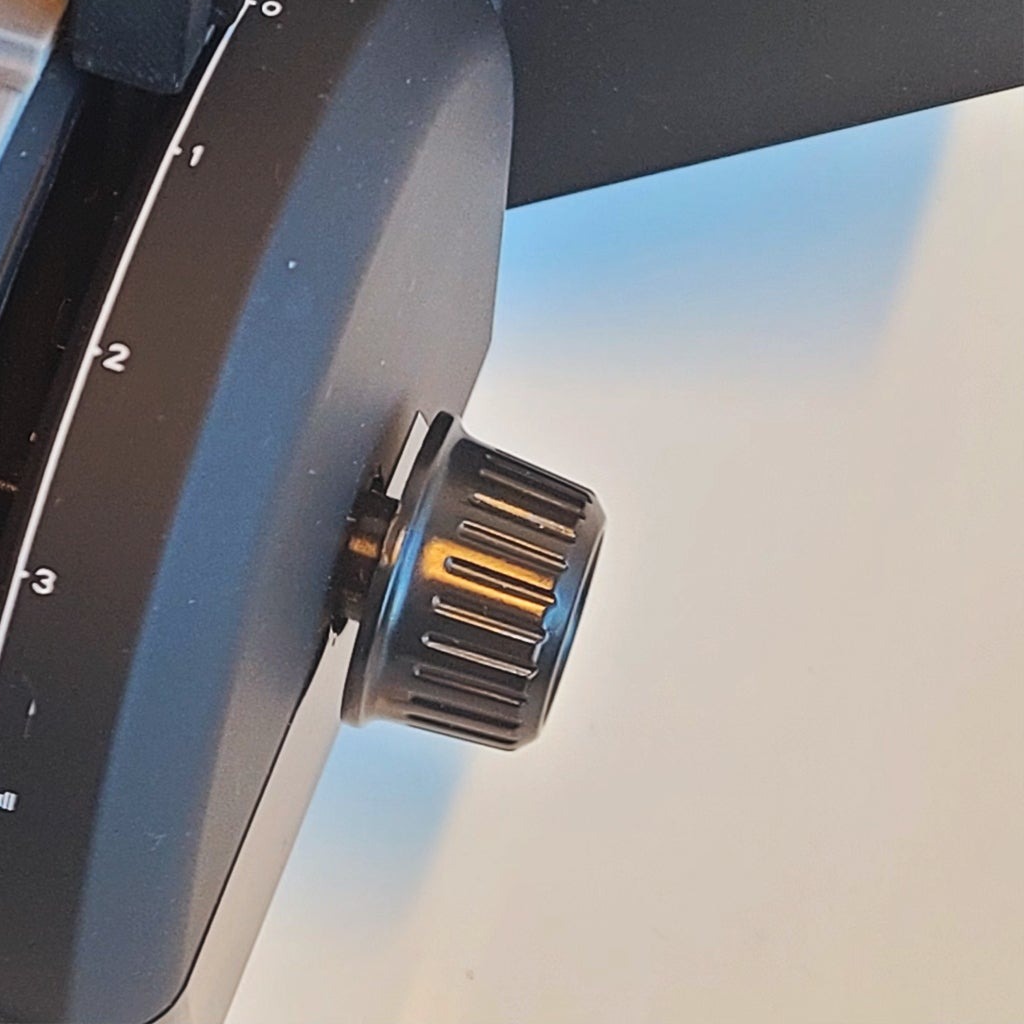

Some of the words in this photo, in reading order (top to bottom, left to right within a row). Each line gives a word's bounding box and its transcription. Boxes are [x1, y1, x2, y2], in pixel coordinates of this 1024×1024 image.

[188, 144, 205, 168] 1
[102, 342, 131, 373] 2
[31, 566, 58, 596] 3
